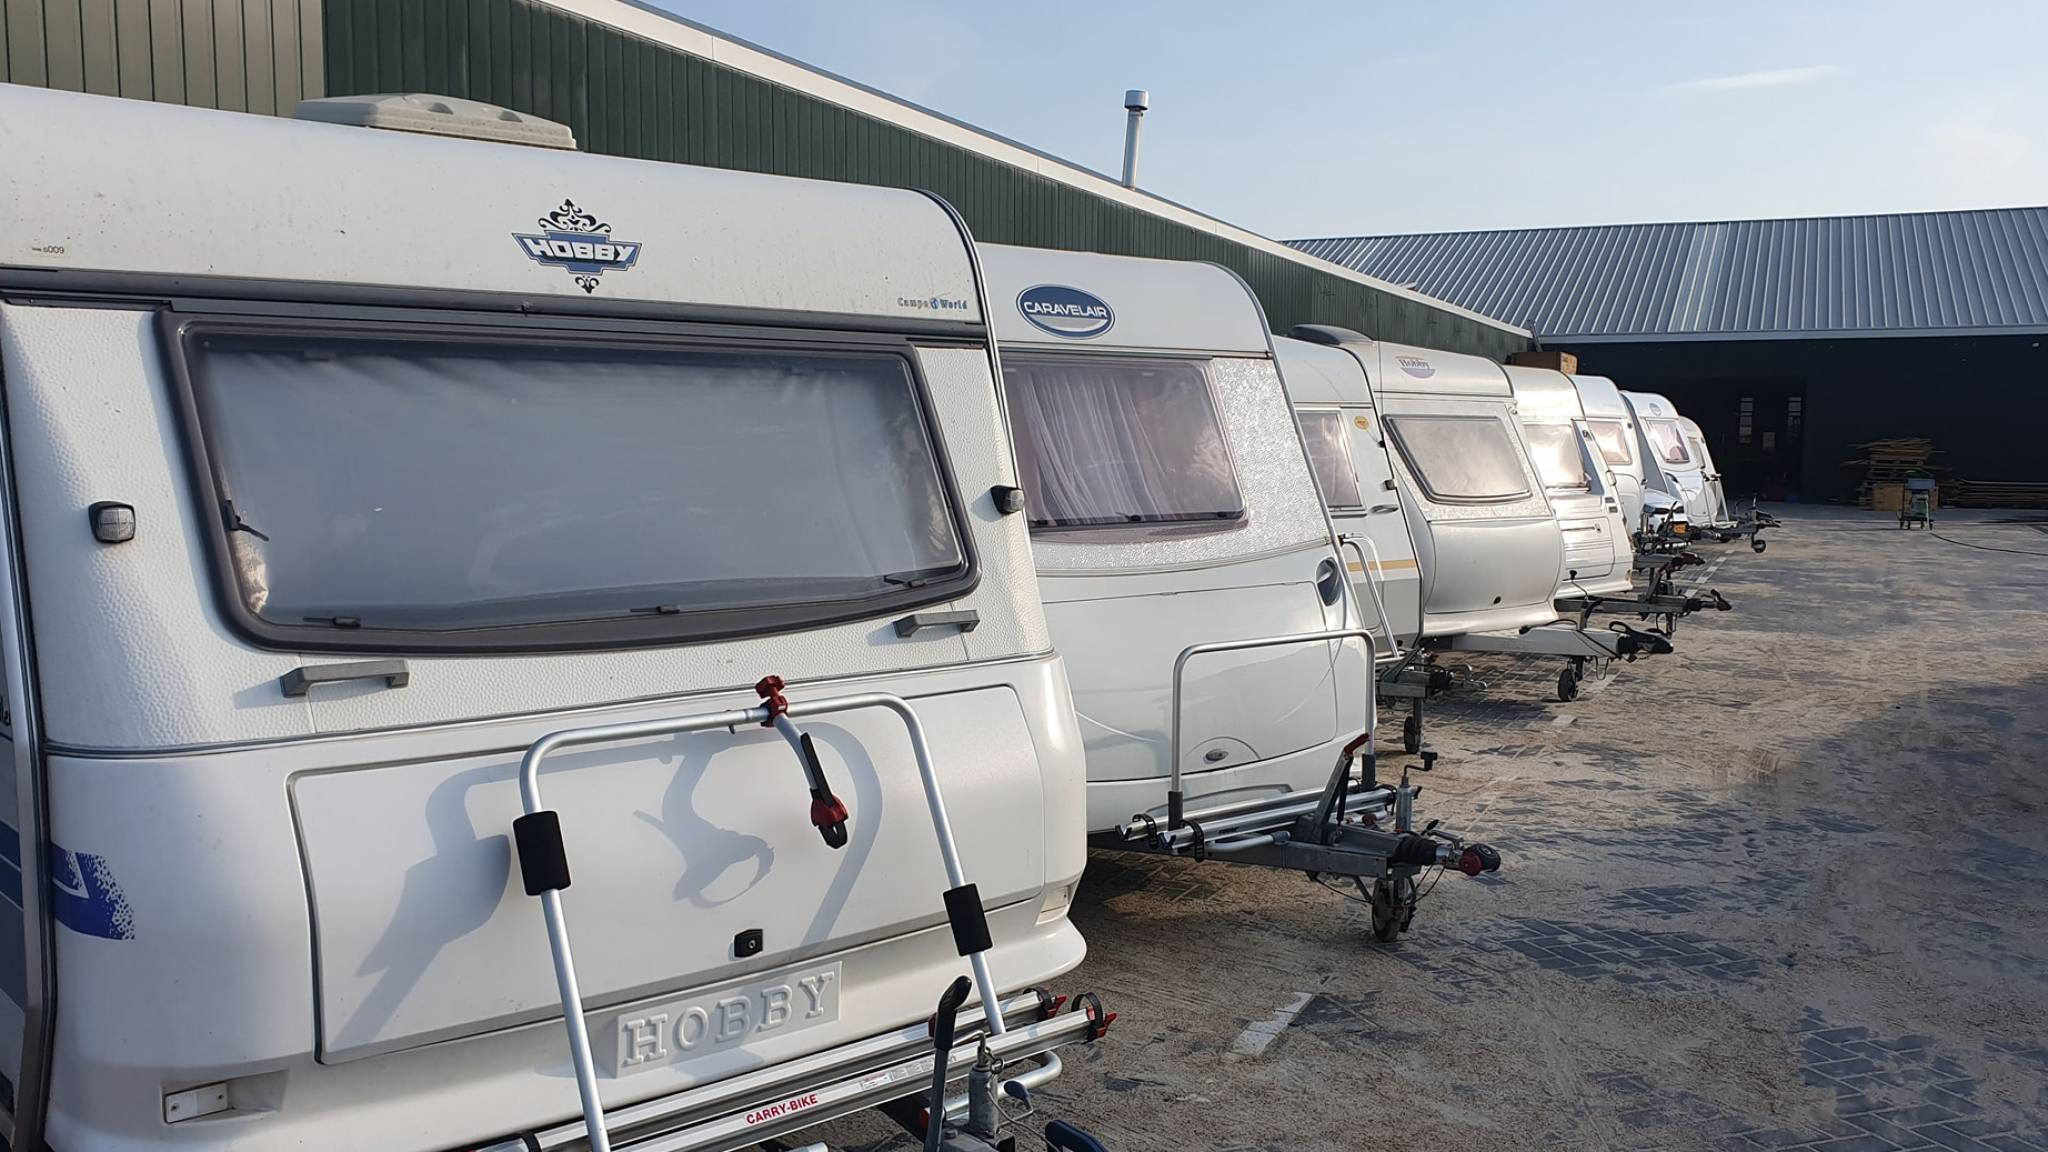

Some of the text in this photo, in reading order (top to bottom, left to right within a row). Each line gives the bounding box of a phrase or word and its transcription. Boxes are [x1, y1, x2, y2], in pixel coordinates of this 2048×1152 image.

[522, 238, 635, 262] HOBBY
[940, 299, 968, 309] World
[1023, 301, 1108, 318] CARAVELAIR
[621, 971, 836, 1067] HOBBY
[746, 1093, 819, 1125] CARRY-BIKE
